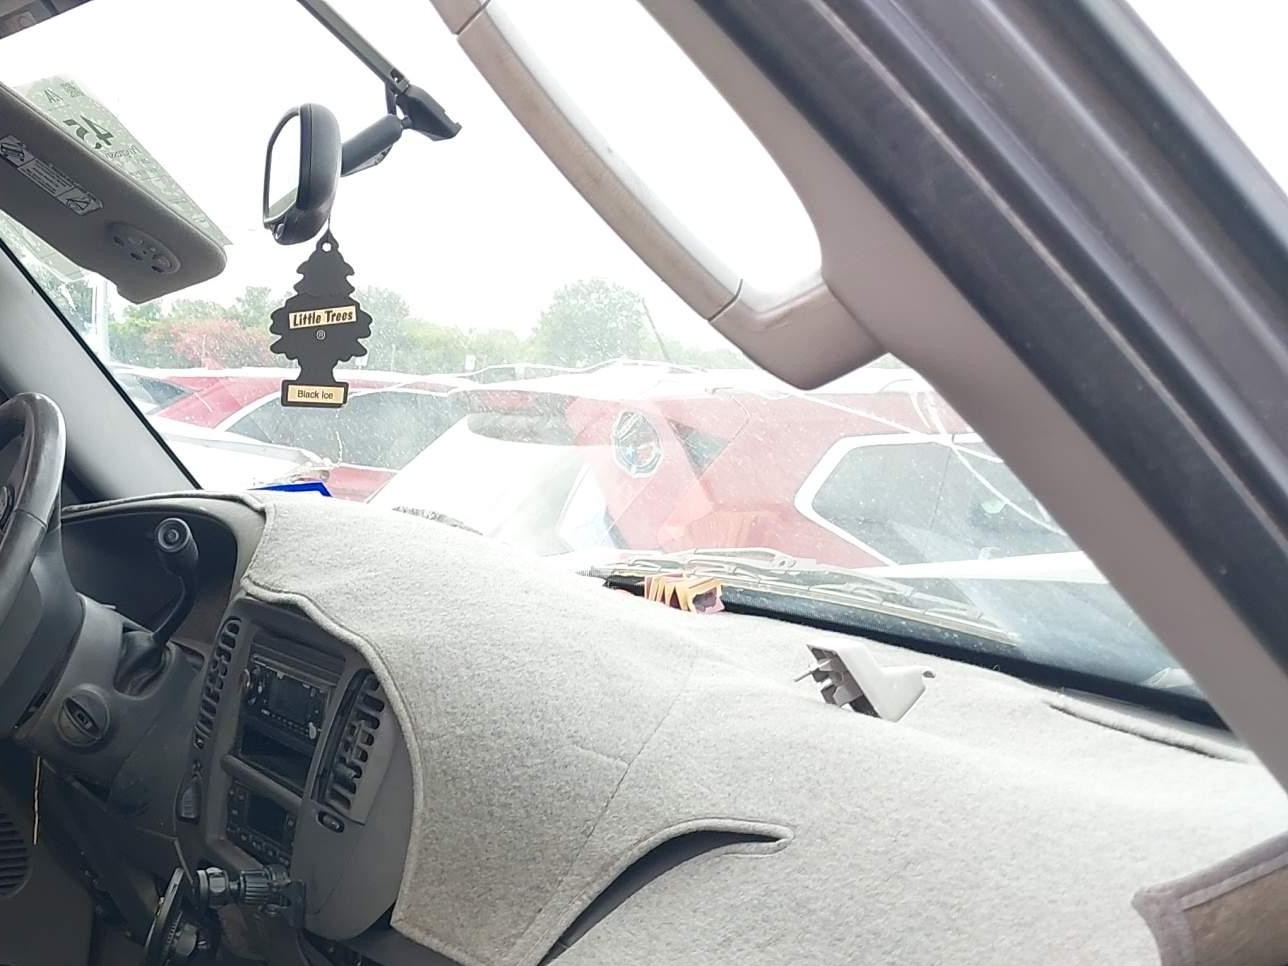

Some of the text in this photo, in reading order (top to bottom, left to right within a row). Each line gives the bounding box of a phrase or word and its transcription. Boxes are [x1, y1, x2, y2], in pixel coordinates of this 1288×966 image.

[293, 310, 353, 327] Little Trees
[297, 389, 319, 399] Black
